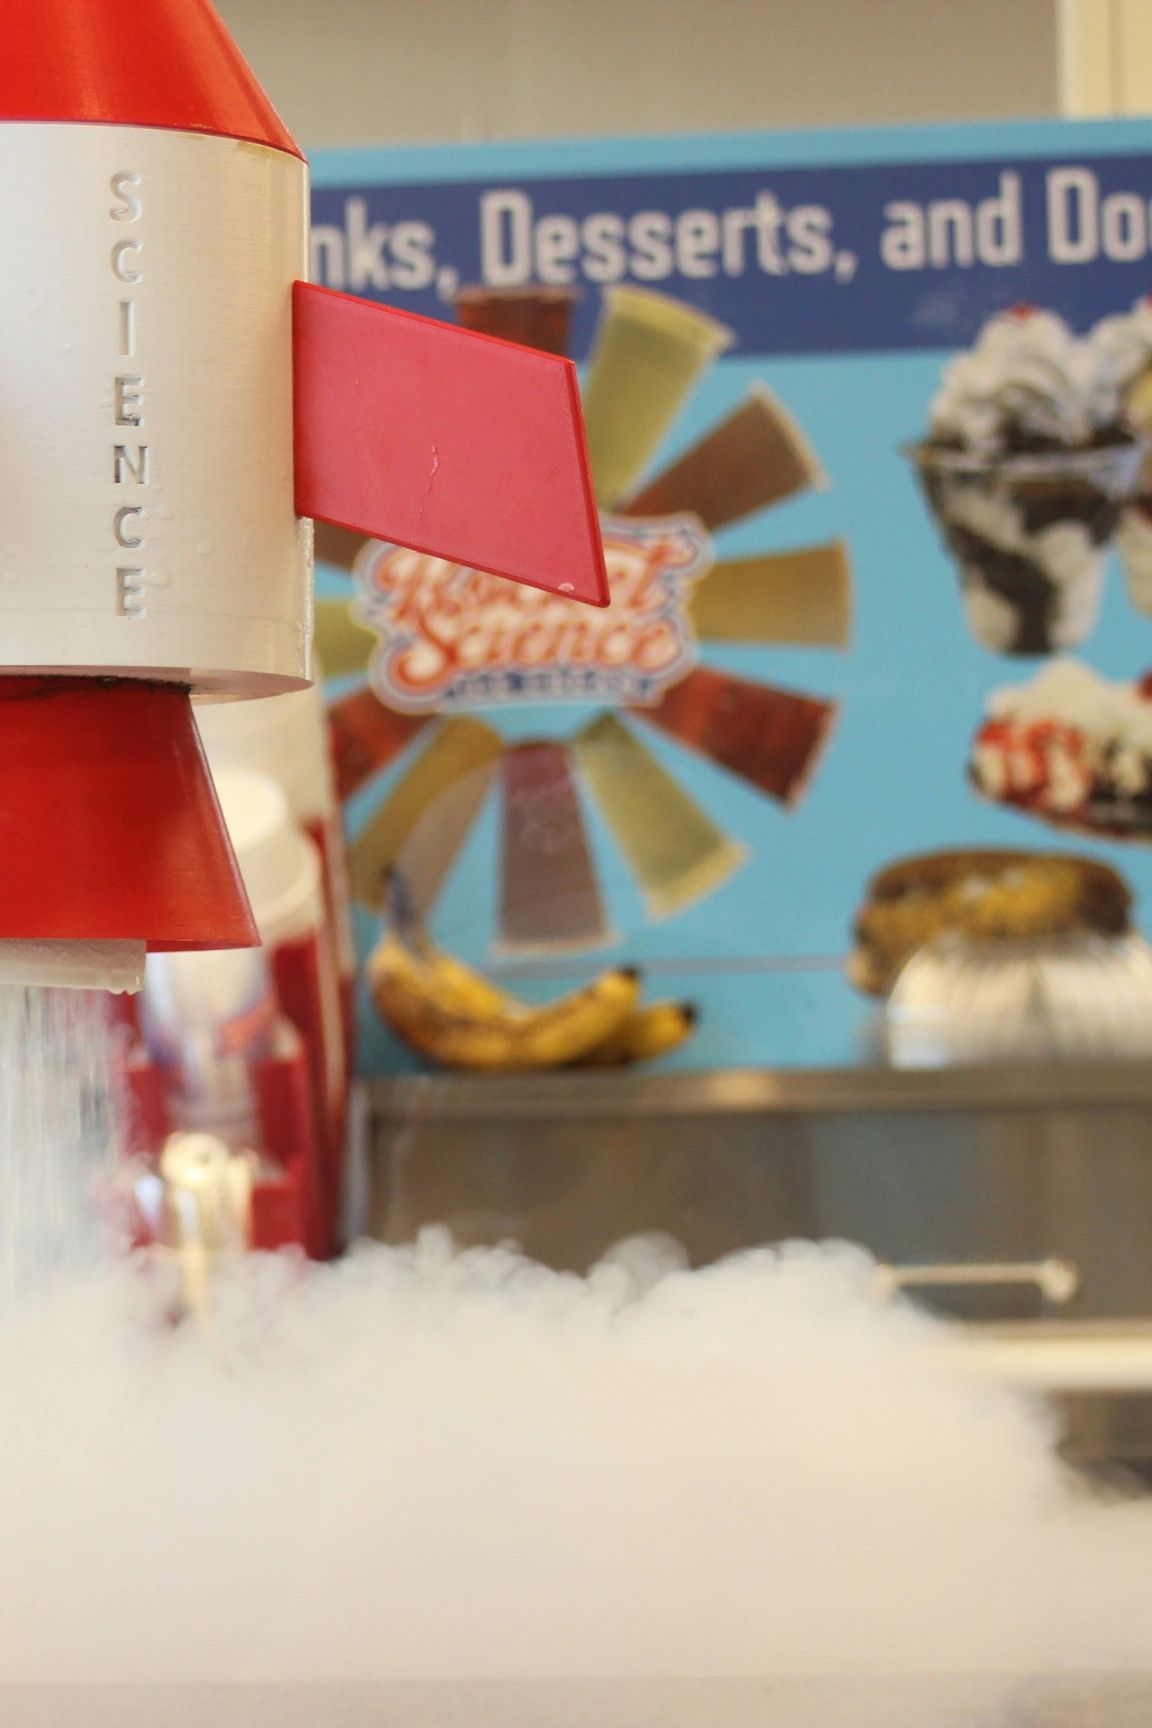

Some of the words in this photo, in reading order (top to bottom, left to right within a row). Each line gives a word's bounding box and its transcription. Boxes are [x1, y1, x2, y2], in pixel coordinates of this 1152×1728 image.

[480, 187, 858, 286] Desserts,
[880, 168, 1023, 271] and
[1045, 165, 1152, 265] Do
[110, 169, 149, 617] SCIENCE
